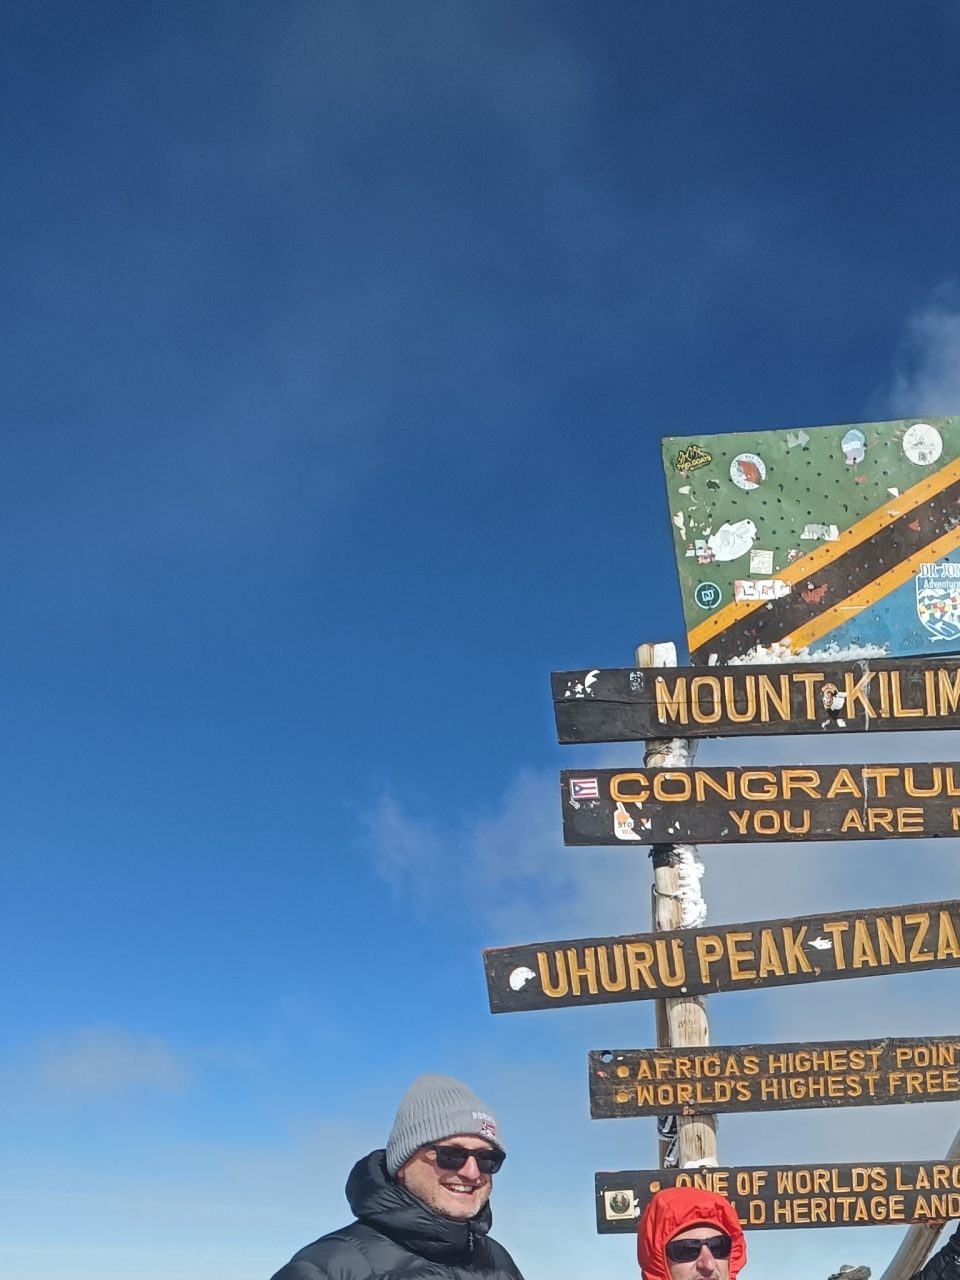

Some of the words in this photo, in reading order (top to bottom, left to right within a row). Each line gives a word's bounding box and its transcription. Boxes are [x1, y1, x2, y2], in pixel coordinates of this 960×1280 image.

[919, 563, 937, 578] DR
[655, 672, 823, 724] MOUNT
[729, 809, 811, 835] YOU
[841, 807, 924, 833] ARE
[538, 938, 686, 997] UHURU
[703, 927, 822, 983] PEAK,
[768, 1048, 884, 1075] HIGHEST
[637, 1079, 751, 1107] WORLD'S
[761, 1072, 880, 1100] HIGHEST
[736, 1170, 769, 1196] OF
[776, 1166, 888, 1196] WORLD'S
[773, 1195, 906, 1224] HERITAGE
